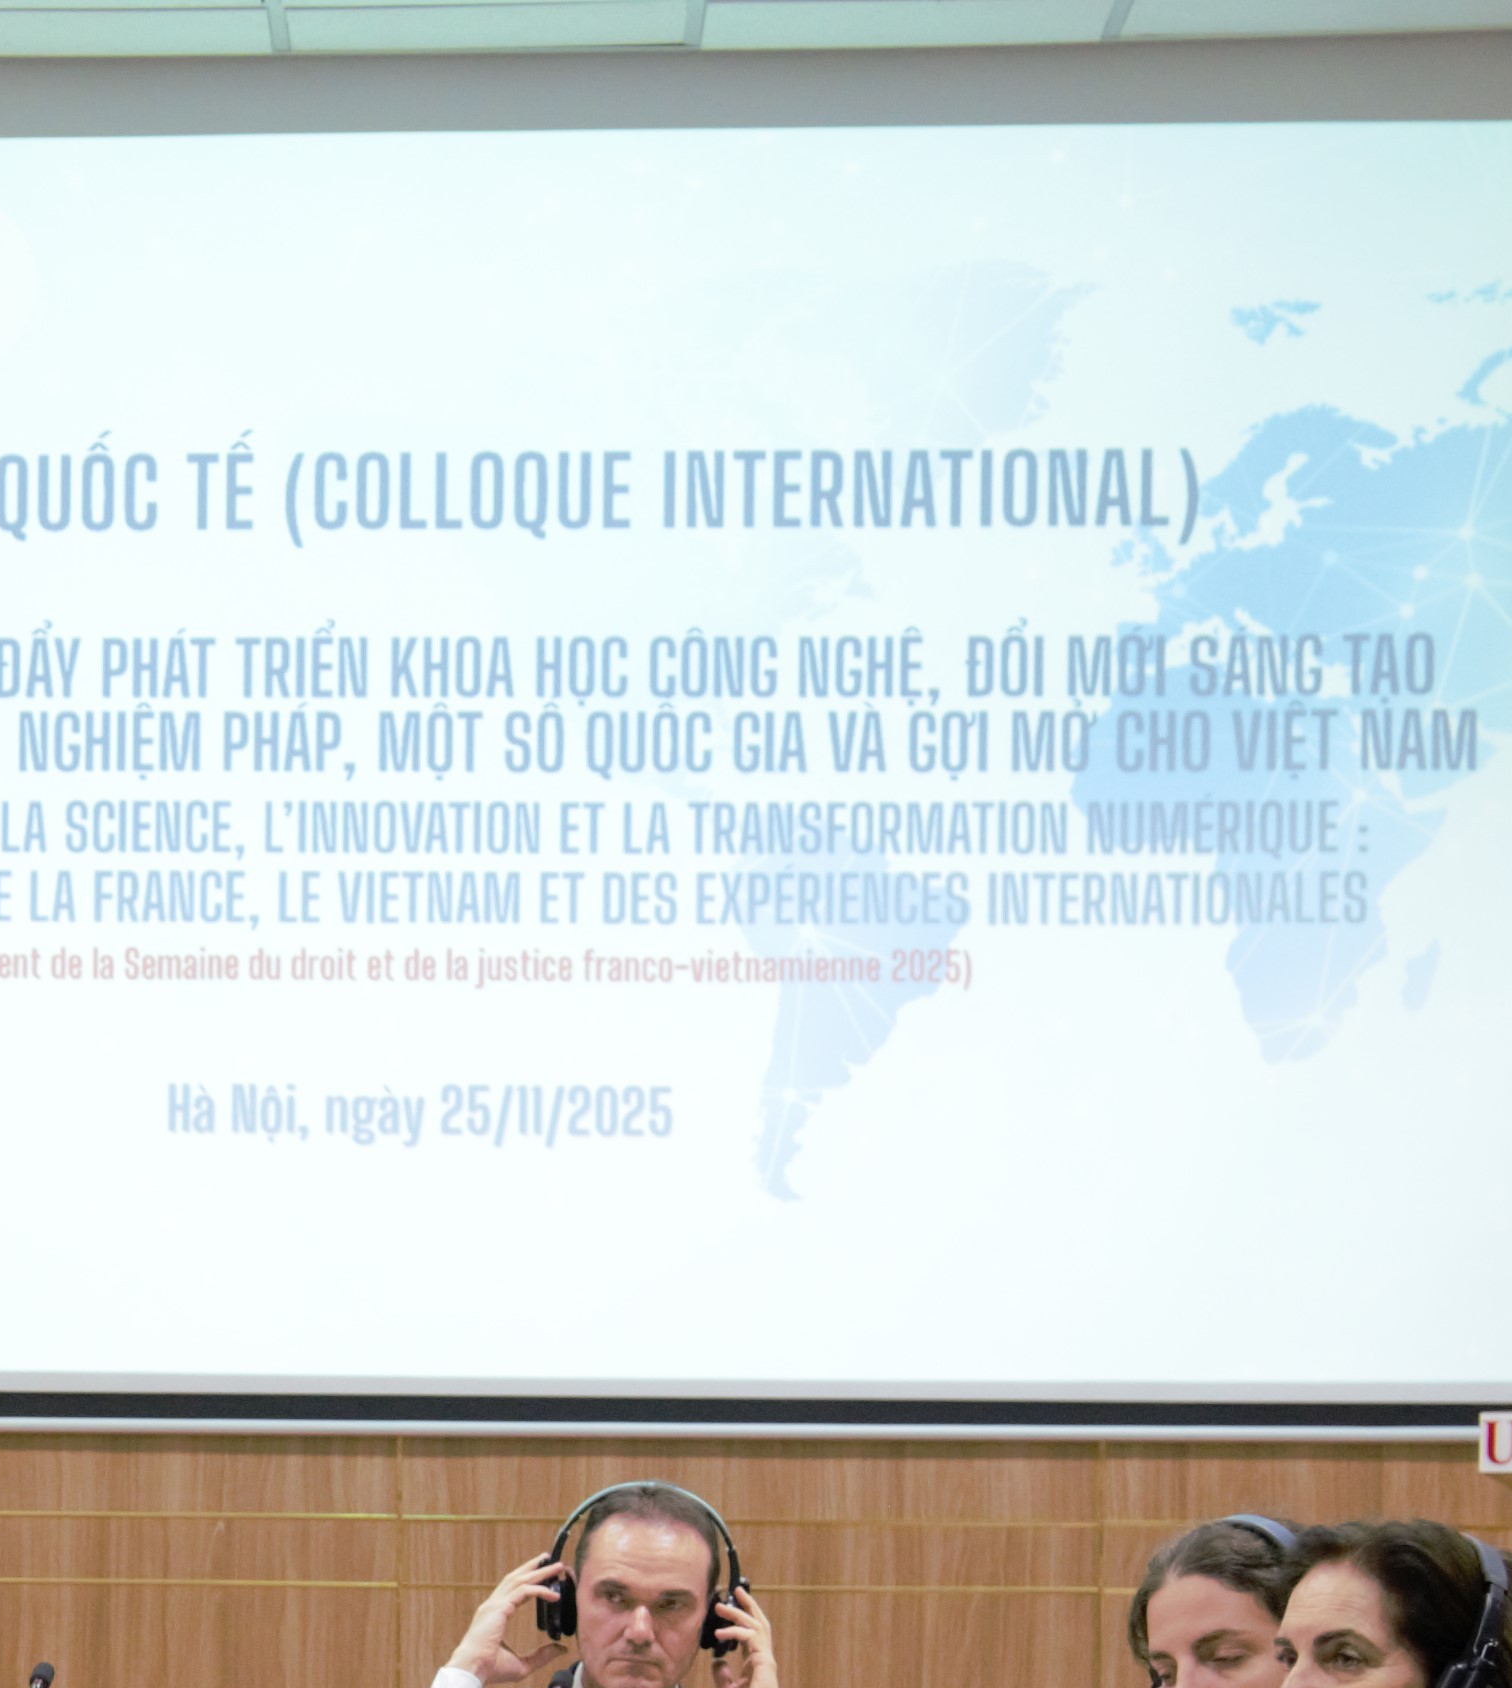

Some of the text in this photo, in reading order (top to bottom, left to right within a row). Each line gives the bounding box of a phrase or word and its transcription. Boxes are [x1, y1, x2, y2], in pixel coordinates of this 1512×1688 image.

[186, 428, 256, 531] TẾ
[285, 450, 632, 548] (COLLOQUE
[661, 447, 1202, 546] INTERNATIONAL)
[101, 628, 216, 700] PHÁT
[235, 619, 368, 700] TRIỂN
[390, 636, 515, 700] KHOA
[535, 635, 629, 708] HỌC
[648, 626, 778, 699] CÔNG
[797, 627, 941, 709] NGHỆ,
[965, 617, 1045, 698] ĐỔI
[1067, 625, 1166, 698] MỚI
[1189, 625, 1324, 698] SÁNG
[1342, 631, 1436, 704] TẠO
[18, 702, 202, 781] NGHIỆM
[222, 702, 357, 781] PHÁP,
[378, 702, 483, 781] MỘT
[504, 692, 565, 773] SỐ
[585, 693, 713, 780] QUỐC
[732, 711, 808, 774] GIA
[827, 703, 887, 772] VÀ
[907, 711, 989, 782] GỢI
[1009, 699, 1097, 773] MỞ
[1115, 710, 1212, 774] CHO
[1232, 701, 1339, 780] VIỆT
[1359, 709, 1478, 771] NAM
[0, 800, 47, 853] LA
[65, 800, 246, 860] SCIENCE,
[264, 800, 541, 855] L’INNOVATION
[560, 801, 606, 855] ET
[623, 802, 670, 855] LA
[689, 801, 1068, 855] TRANSFORMATION
[1087, 792, 1342, 860] NUMÉRIQUE
[29, 869, 77, 922] LA
[93, 870, 260, 929] FRANCE,
[278, 871, 322, 924] LE
[337, 871, 521, 924] VIETNAM
[539, 871, 586, 925] ET
[602, 871, 677, 925] DES
[696, 864, 971, 926] EXPÉRIENCES
[987, 870, 1369, 926] INTERNATIONALES
[50, 946, 83, 980] de
[92, 946, 114, 980] la
[124, 947, 239, 981] Semaine
[248, 947, 282, 981] du
[291, 947, 357, 982] droit
[367, 950, 395, 982] et
[404, 948, 437, 982] de
[446, 949, 468, 982] la
[475, 949, 573, 989] justice
[584, 949, 880, 983] franco-vietnamienne
[892, 949, 973, 991] 2025)
[167, 1082, 674, 1149] Hà Nội, ngày 25/11/2025
